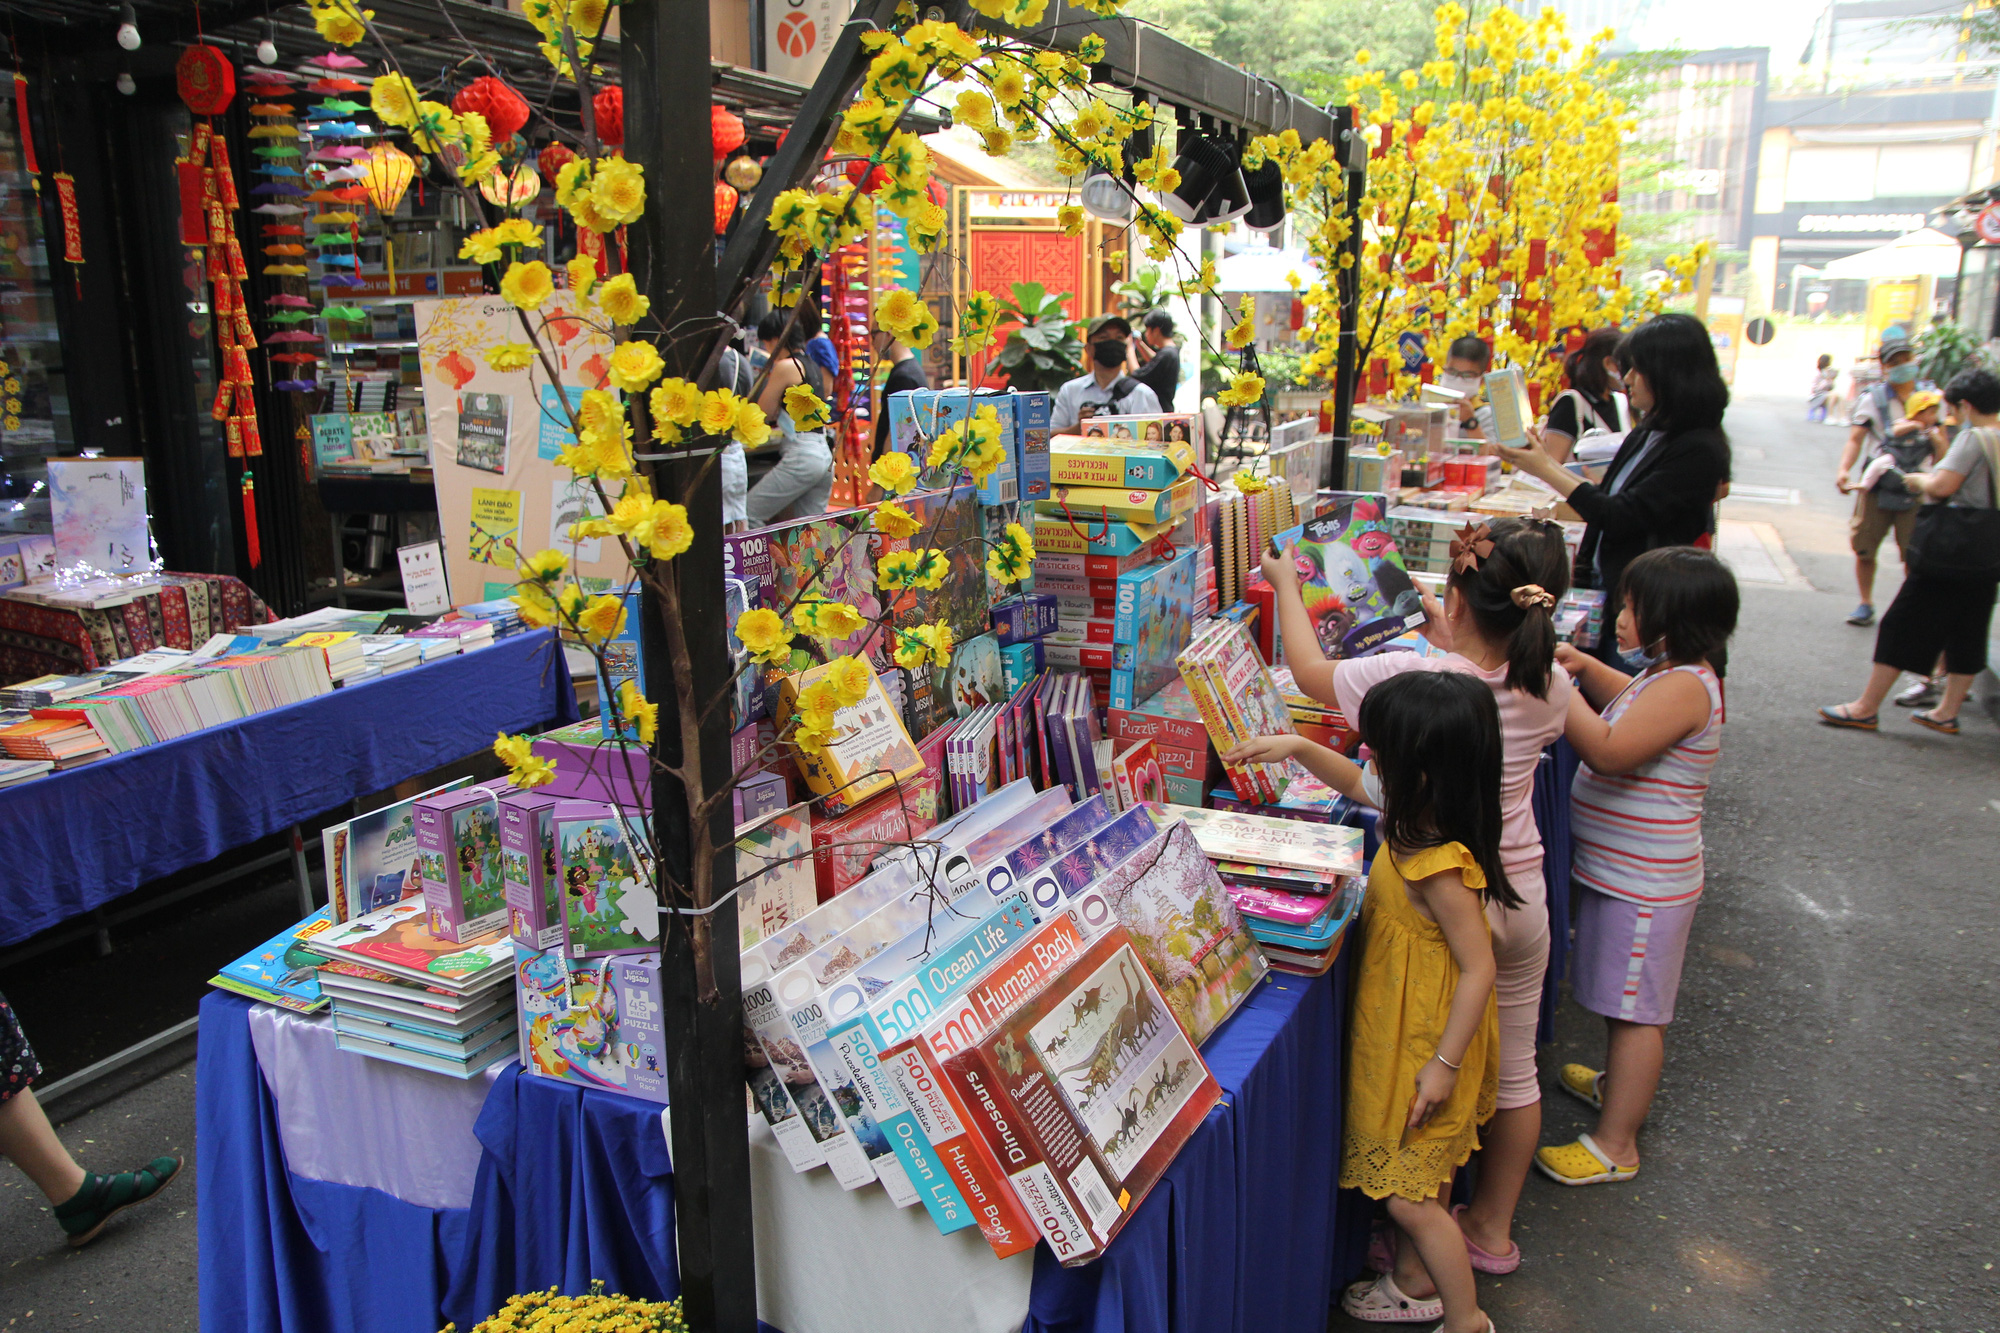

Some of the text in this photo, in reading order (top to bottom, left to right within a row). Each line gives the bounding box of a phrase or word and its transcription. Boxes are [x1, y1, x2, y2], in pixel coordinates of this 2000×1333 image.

[320, 427, 345, 437] DEBATE
[461, 422, 504, 437] THÔNG MINH
[1068, 459, 1109, 469] NECKLACES
[1058, 471, 1082, 480] MATCH
[1091, 472, 1106, 481] MIX
[1107, 473, 1118, 482] MY
[740, 538, 763, 557] 100
[1056, 539, 1070, 548] MIX
[1073, 539, 1082, 549] MY
[743, 554, 769, 567] CHILDREN'S
[744, 563, 770, 575] SPARKLY
[1046, 563, 1080, 571] STICKERS
[1052, 583, 1086, 591] STICKERS
[1064, 600, 1092, 609] flowers
[1118, 582, 1135, 614] 100
[1191, 688, 1218, 738] COLORING CUTE
[1203, 693, 1229, 742] COLORING CUTE
[1221, 691, 1247, 740] COLORING CUTE
[1163, 720, 1194, 737] TIME
[817, 756, 823, 765] in
[827, 772, 838, 790] Box
[1166, 778, 1188, 794] IME
[1231, 776, 1242, 793] KLUTZ
[1245, 781, 1255, 797] KLUTZ
[1261, 779, 1271, 795] KLUTZ
[881, 808, 897, 820] Disney
[419, 828, 440, 840] Princess
[504, 827, 524, 840] Princess
[871, 814, 907, 850] MULAN
[1204, 829, 1293, 845] ORIGAMI
[1206, 821, 1302, 839] COMPLETE
[423, 836, 438, 846] Picnic
[508, 836, 522, 847] Picnic
[977, 962, 1038, 1020] Human
[1032, 927, 1078, 971] Body
[876, 924, 1008, 1044] 500 Ocean Life
[629, 999, 647, 1012] 45
[743, 988, 772, 1012] 1000
[630, 1010, 648, 1018] PIECE
[751, 1007, 781, 1028] PUZZLE
[791, 1003, 823, 1028] 1000
[624, 1018, 660, 1032] PUZZLE
[848, 1029, 879, 1070] 500
[633, 1073, 661, 1085] Unicorn
[840, 1042, 877, 1111] Puzzlebilities
[901, 1052, 932, 1093] 500
[639, 1082, 657, 1092] Race
[870, 1071, 896, 1111] PUZZLE
[878, 1067, 903, 1107] PIECE JIGSAW
[893, 1066, 932, 1134] Puzzlebilities
[925, 1094, 951, 1134] PUZZLE
[932, 1090, 958, 1131] PIECE JIGSAW
[965, 1071, 1026, 1164] Dinosaurs
[895, 1121, 957, 1221] Ocean Life
[948, 1145, 1012, 1244] Human Body
[1018, 1178, 1043, 1217] PIECE JIGSAW
[1027, 1174, 1054, 1219] PUZZLE
[1043, 1172, 1083, 1241] Puzzlebilities
[1044, 1217, 1074, 1256] 500
